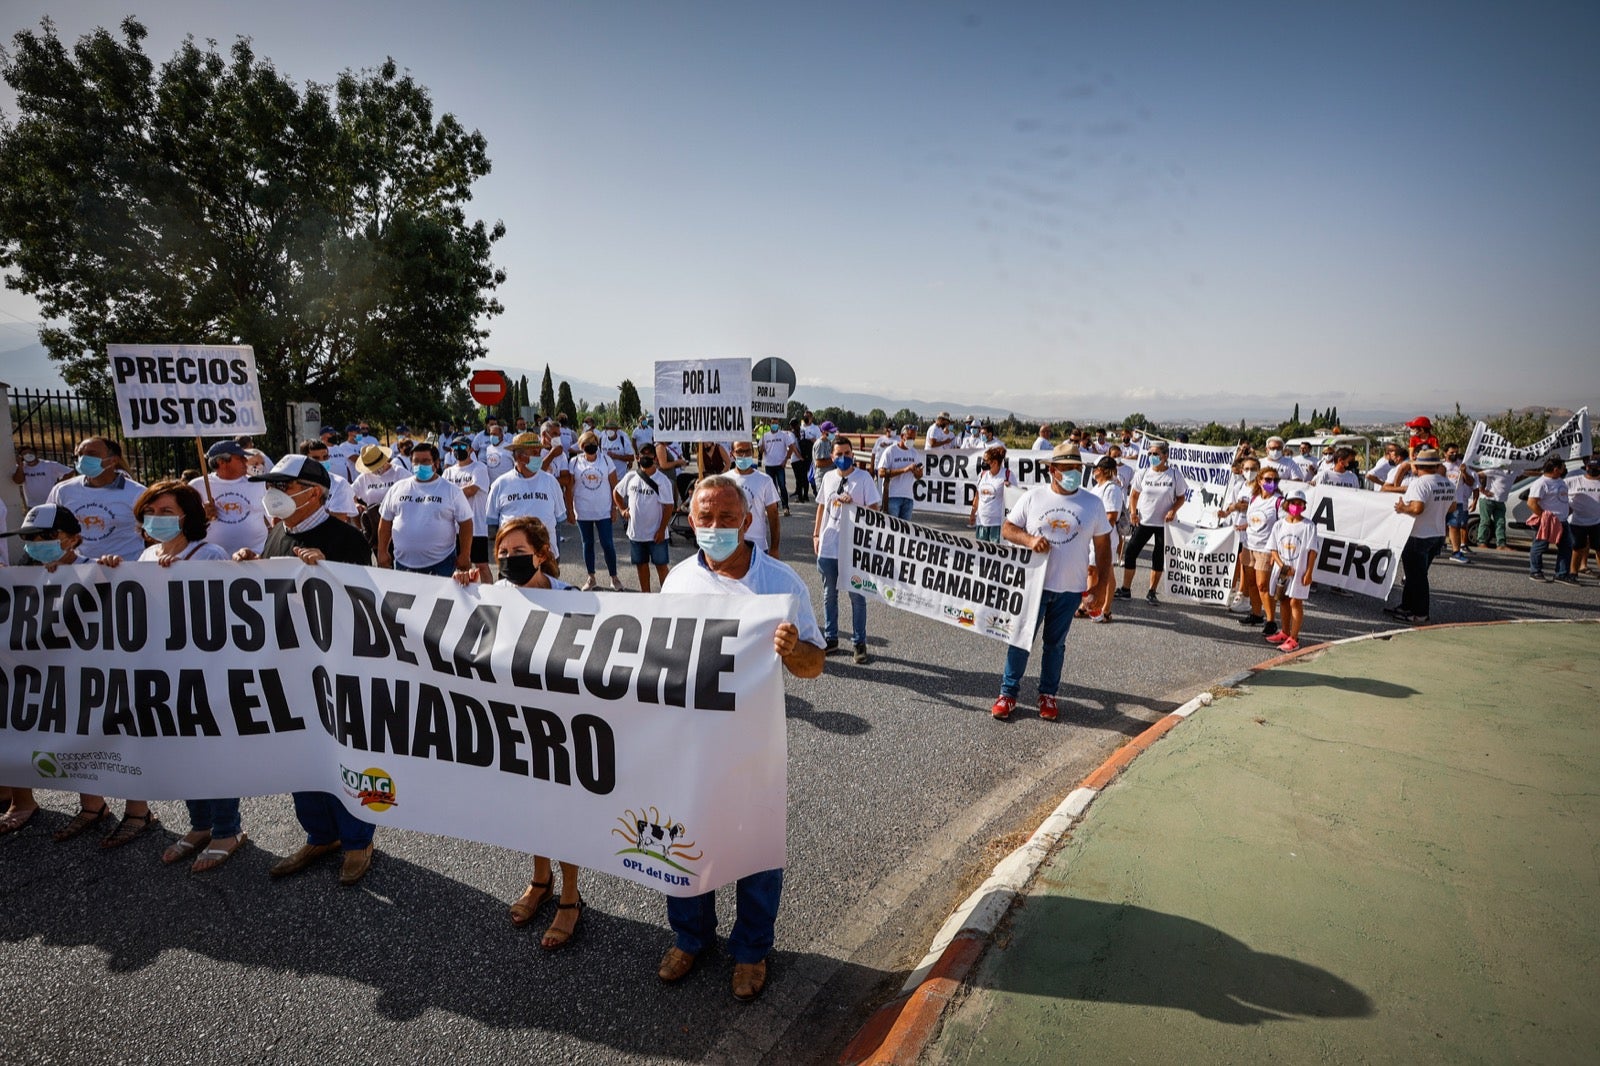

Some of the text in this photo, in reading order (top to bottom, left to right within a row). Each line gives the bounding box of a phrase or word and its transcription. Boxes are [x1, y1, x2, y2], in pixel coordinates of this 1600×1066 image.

[114, 356, 249, 385] PRECIOS
[683, 369, 721, 395] POR LA
[757, 386, 776, 397] POR LA
[129, 397, 238, 430] JUSTOS
[658, 406, 745, 432] SUPERVIVENCIA
[1481, 434, 1495, 444] DE
[1188, 447, 1234, 465] SUPLICAMOS
[1477, 445, 1506, 459] PARA
[925, 454, 969, 479] POR
[1209, 468, 1230, 487] PARA
[399, 495, 413, 503] OPL
[427, 495, 442, 504] SUR
[507, 491, 548, 501] OPL del SUR
[854, 505, 1033, 565] POR UN PRECIO JUSTO
[853, 527, 1026, 590] DE LA LECHE DE VACA
[1165, 545, 1236, 563] POR UN PRECIO
[1317, 537, 1393, 585] ERO
[1169, 559, 1229, 576] DIGNO DE LA
[852, 549, 895, 580] PARA
[899, 560, 917, 585] EL
[921, 567, 1024, 616] GANADERO
[862, 579, 878, 590] UPA
[1194, 576, 1220, 587] PARA
[1170, 584, 1225, 600] GANADERO
[165, 577, 334, 653] JUSTO
[344, 585, 419, 666] DE
[423, 598, 502, 683] LA
[511, 609, 740, 712] LECHE
[77, 667, 222, 737] PARA
[228, 667, 306, 736] EL
[312, 664, 616, 795] GANADERO
[56, 751, 122, 762] cooperativas
[60, 760, 142, 776] agro-alimentarias
[341, 766, 390, 793] COAG
[623, 858, 691, 886] OPL del SUR
